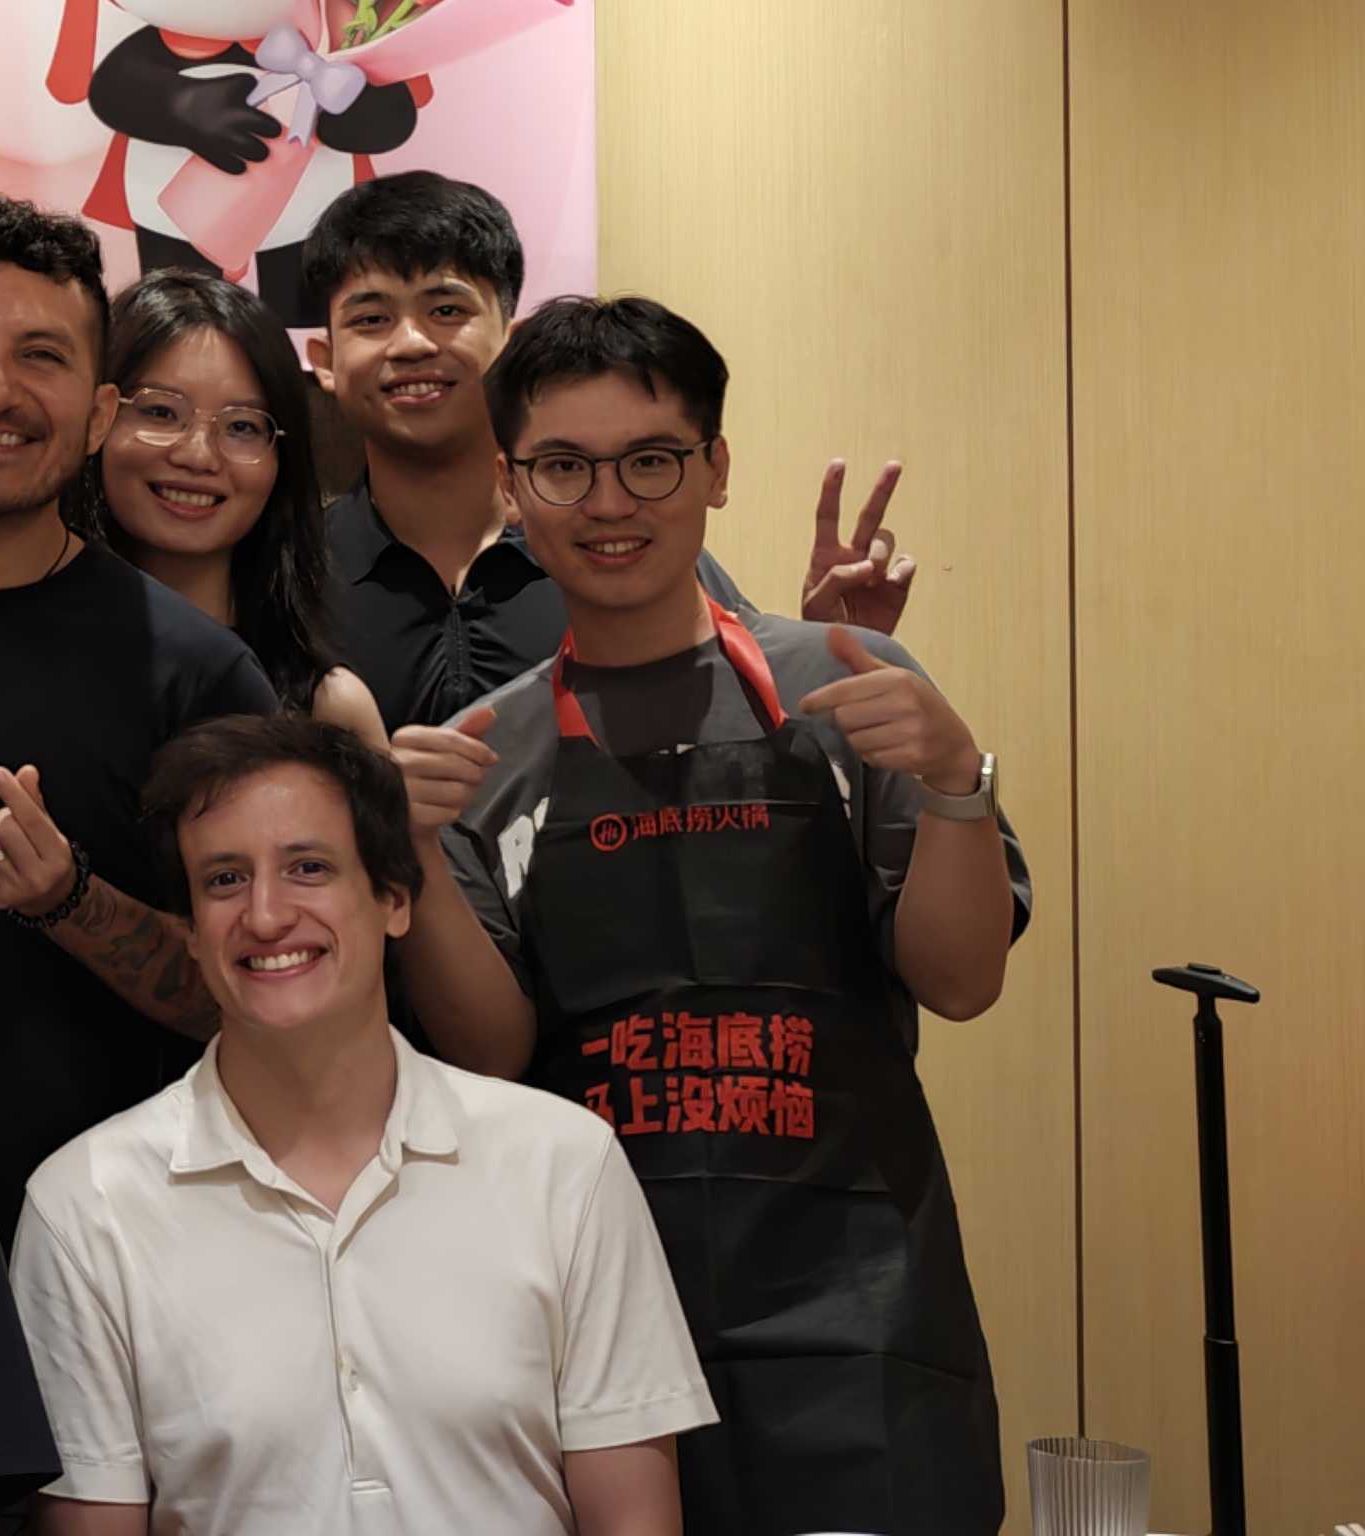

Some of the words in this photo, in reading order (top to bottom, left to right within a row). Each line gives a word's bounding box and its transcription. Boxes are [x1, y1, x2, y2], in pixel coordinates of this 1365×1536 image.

[632, 803, 770, 841] 海底捞火锅
[581, 1012, 814, 1077] 一吃海底捞
